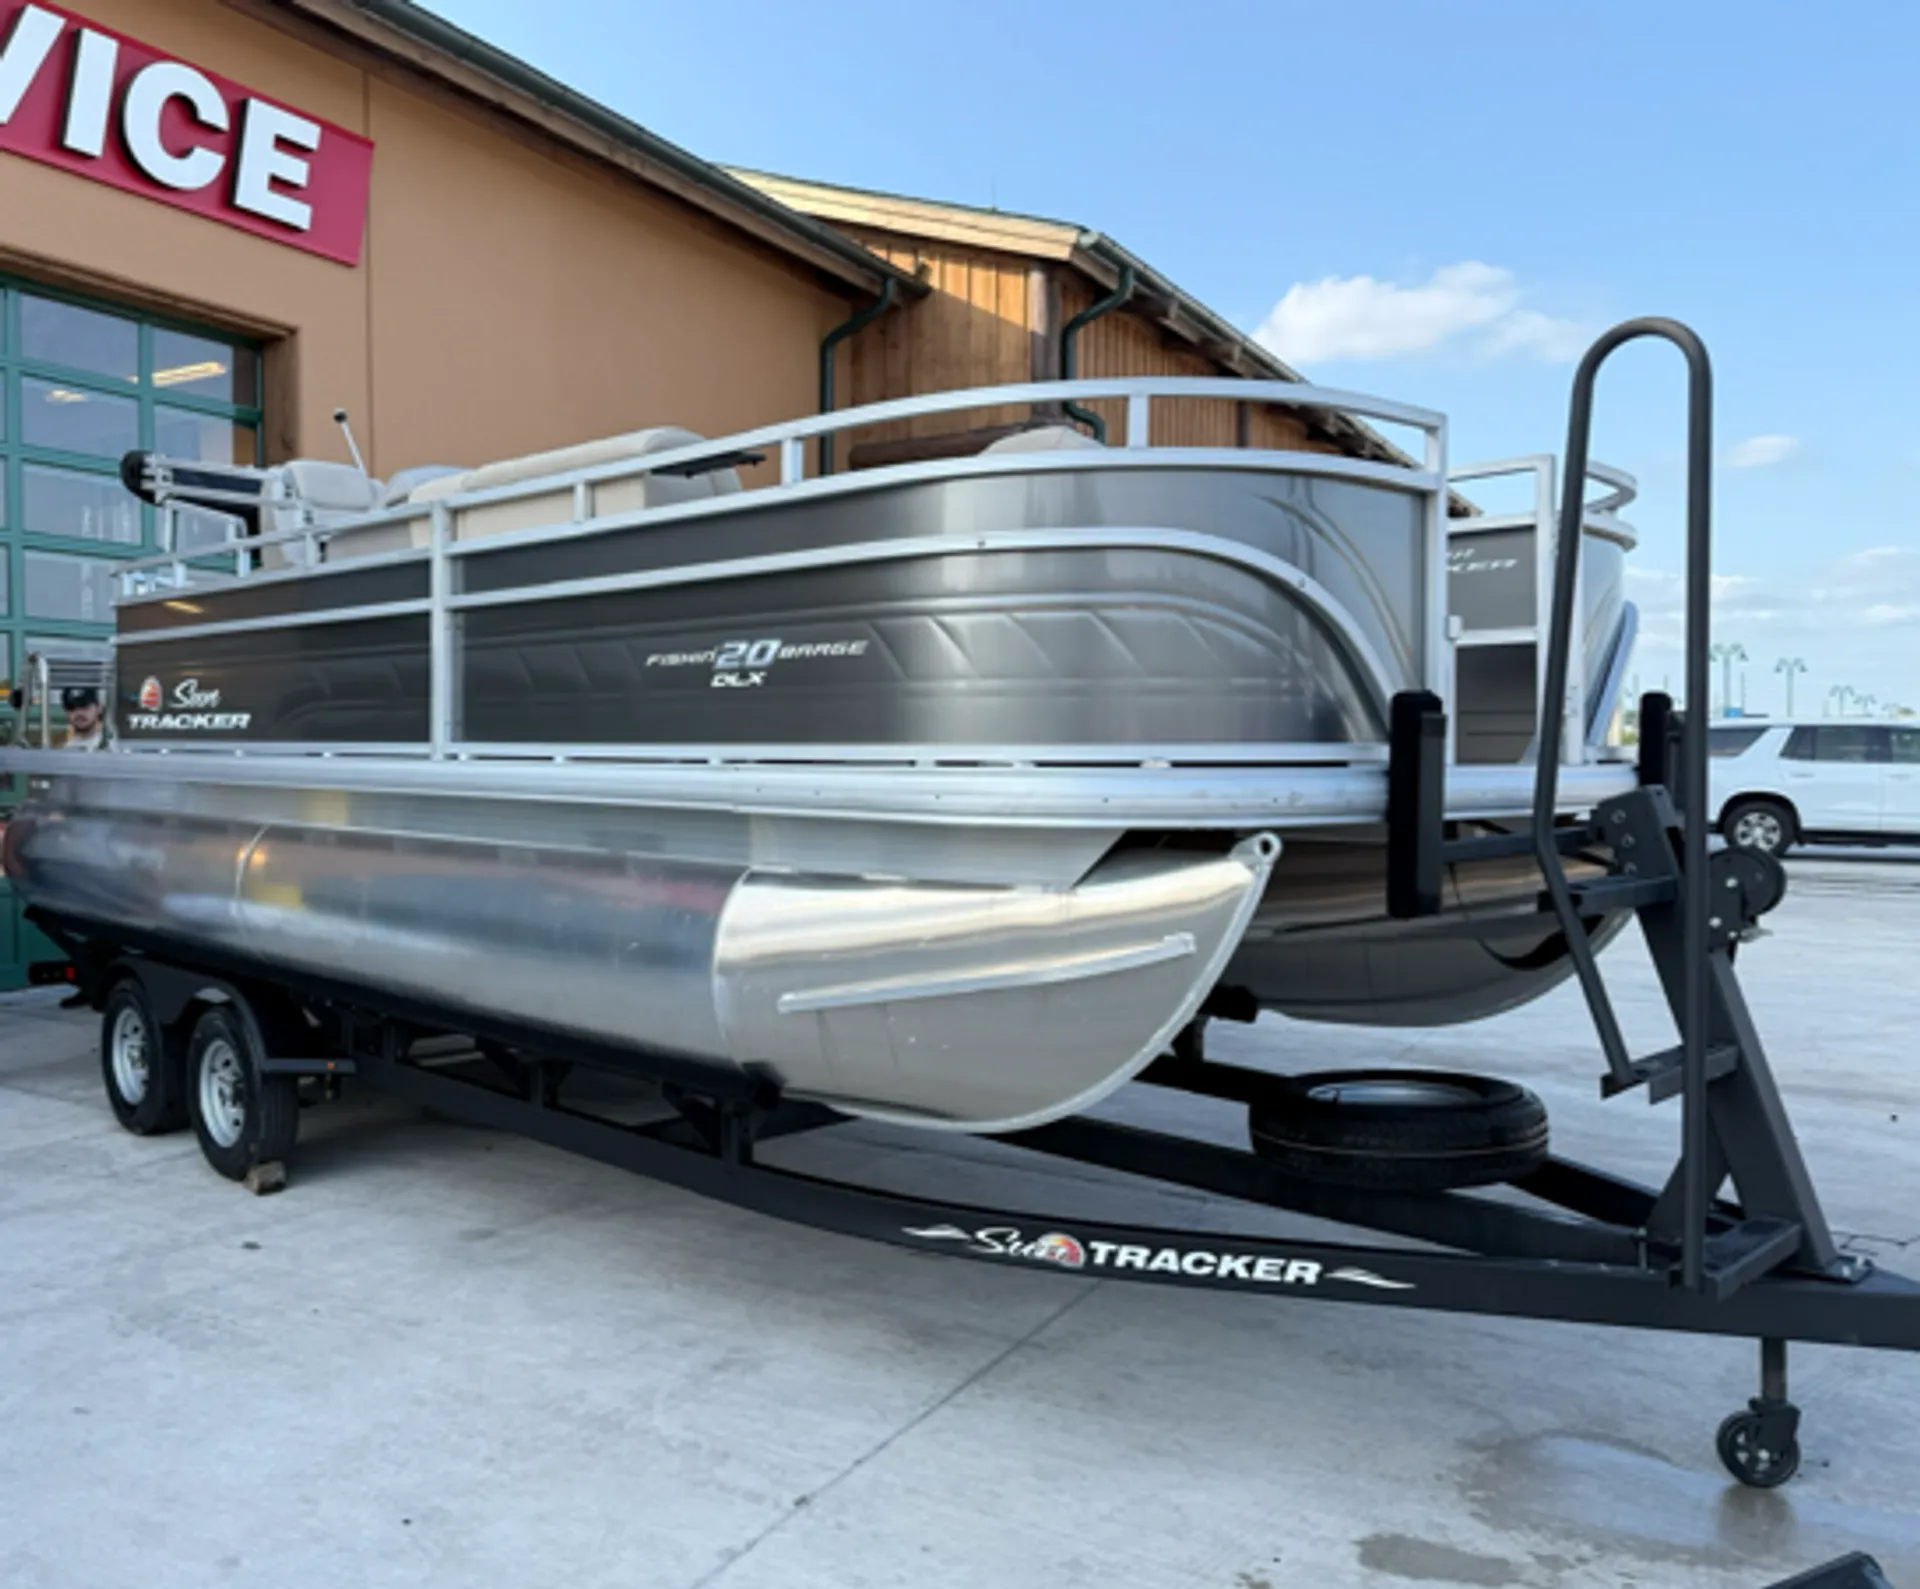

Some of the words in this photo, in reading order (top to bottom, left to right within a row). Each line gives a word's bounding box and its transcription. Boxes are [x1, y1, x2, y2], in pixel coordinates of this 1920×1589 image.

[713, 638, 782, 669] 20
[778, 640, 869, 659] BARGE
[710, 671, 767, 688] DLX
[128, 712, 252, 730] TRACKER
[1088, 1240, 1323, 1285] TRACKER
